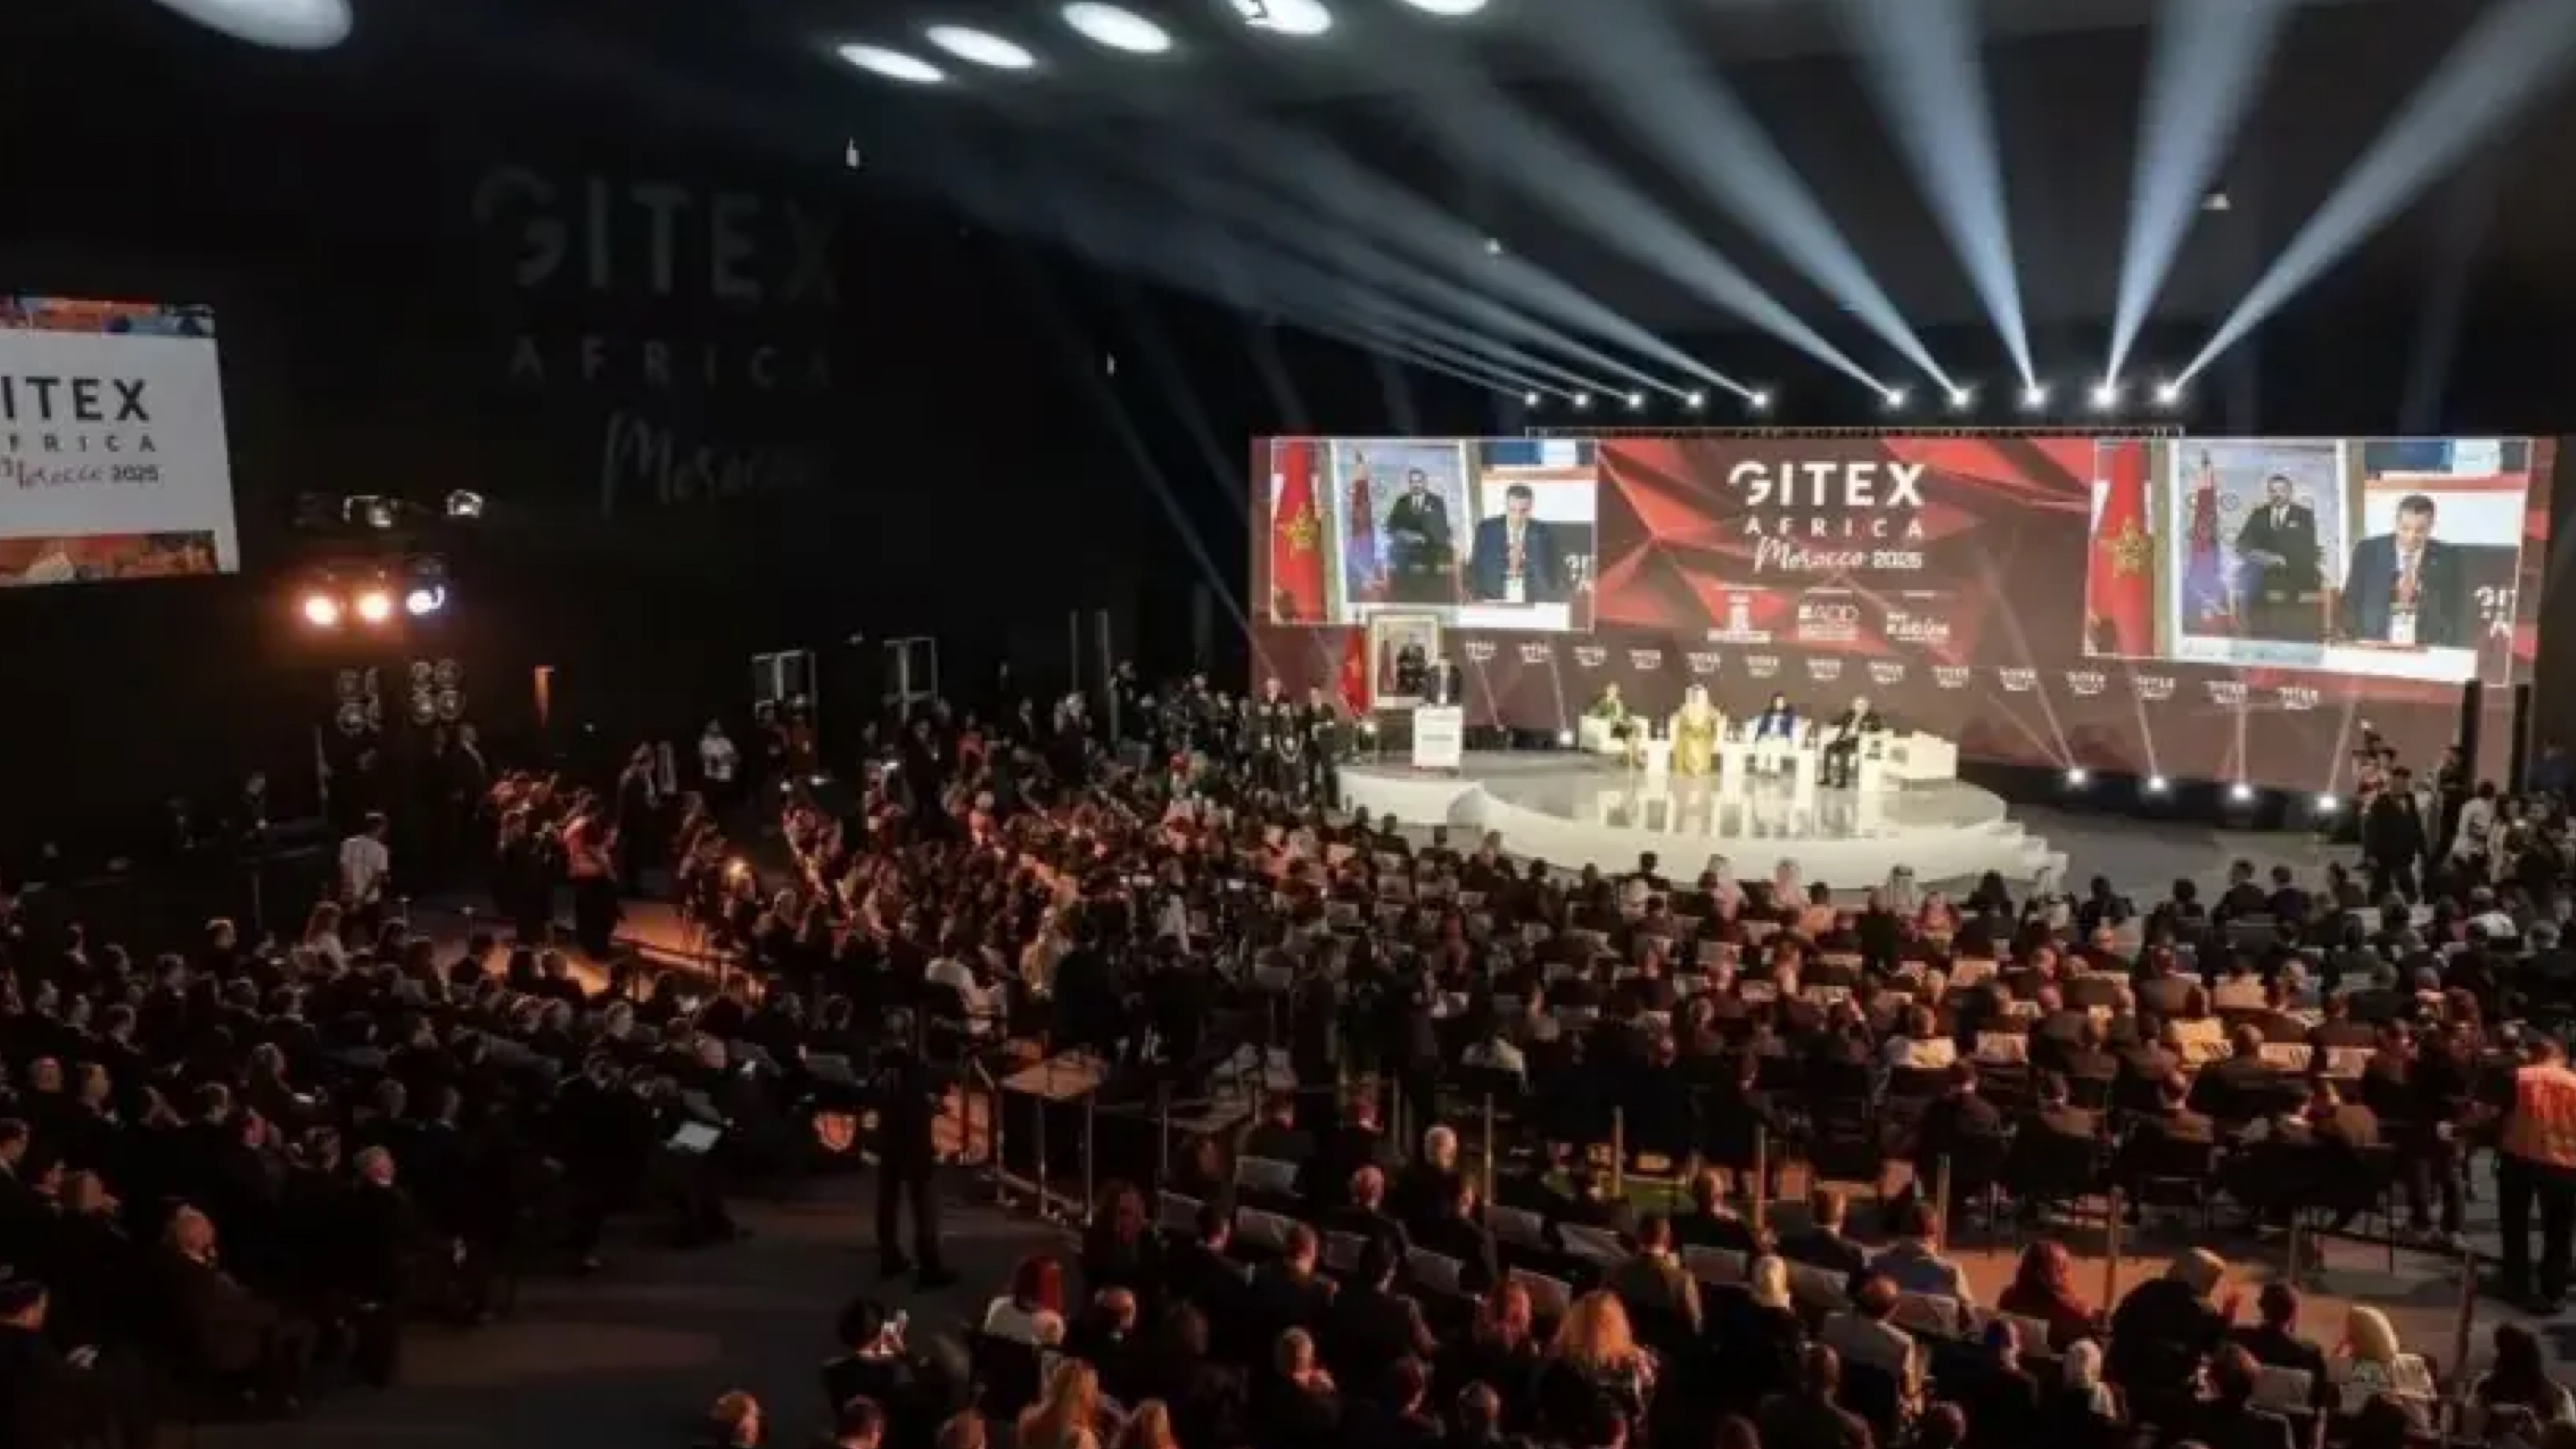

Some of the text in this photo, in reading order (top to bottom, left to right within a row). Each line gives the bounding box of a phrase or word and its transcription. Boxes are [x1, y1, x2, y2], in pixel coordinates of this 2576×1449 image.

[471, 165, 840, 310] GITEX
[510, 335, 831, 388] AFRICA
[0, 375, 149, 421] ITEX
[8, 433, 156, 452] FRICA
[1727, 460, 1925, 506] GITEX
[1745, 517, 1924, 537] AFRICA
[1754, 536, 1924, 573] Morocco 2025
